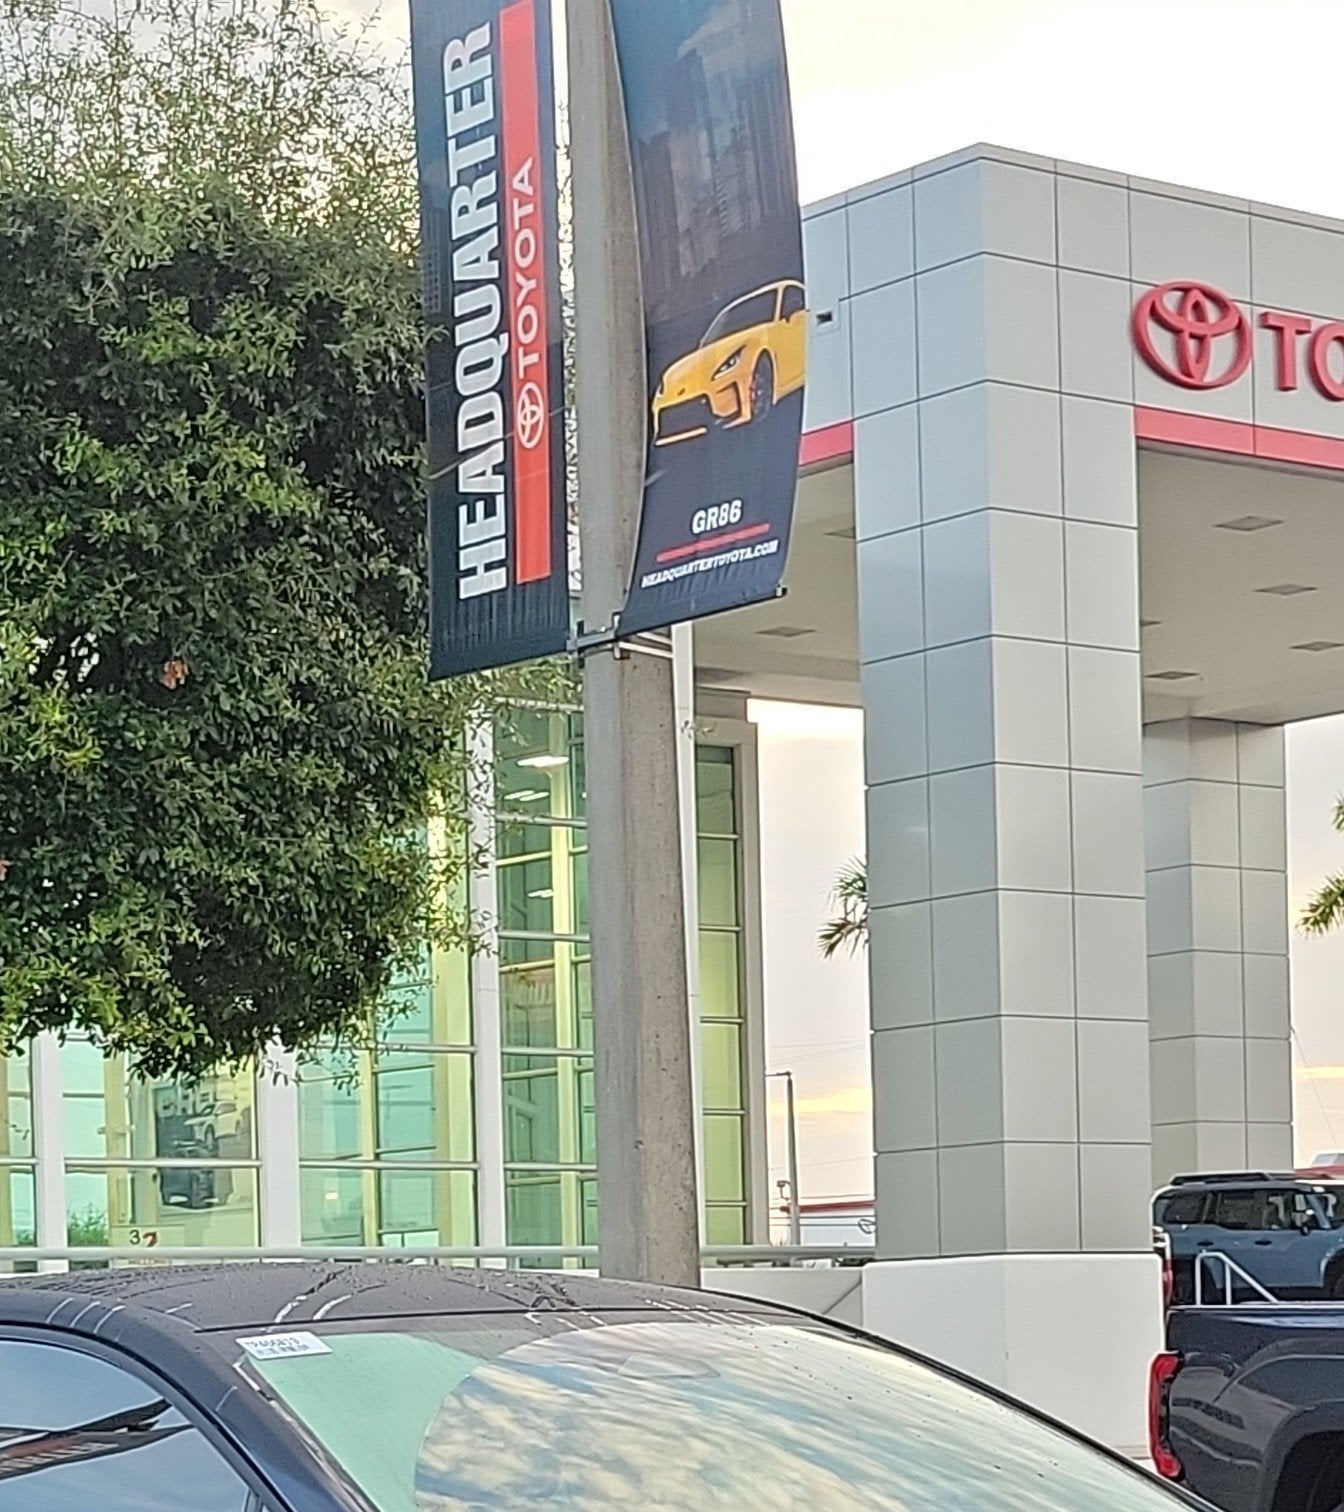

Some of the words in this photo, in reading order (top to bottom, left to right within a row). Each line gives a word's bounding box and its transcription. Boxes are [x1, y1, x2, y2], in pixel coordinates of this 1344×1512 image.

[444, 22, 509, 600] HEADQUARTER
[510, 158, 538, 381] TOYOTA
[641, 539, 779, 588] HEADQUARTERTOYOTA.COM
[691, 500, 742, 534] GR86
